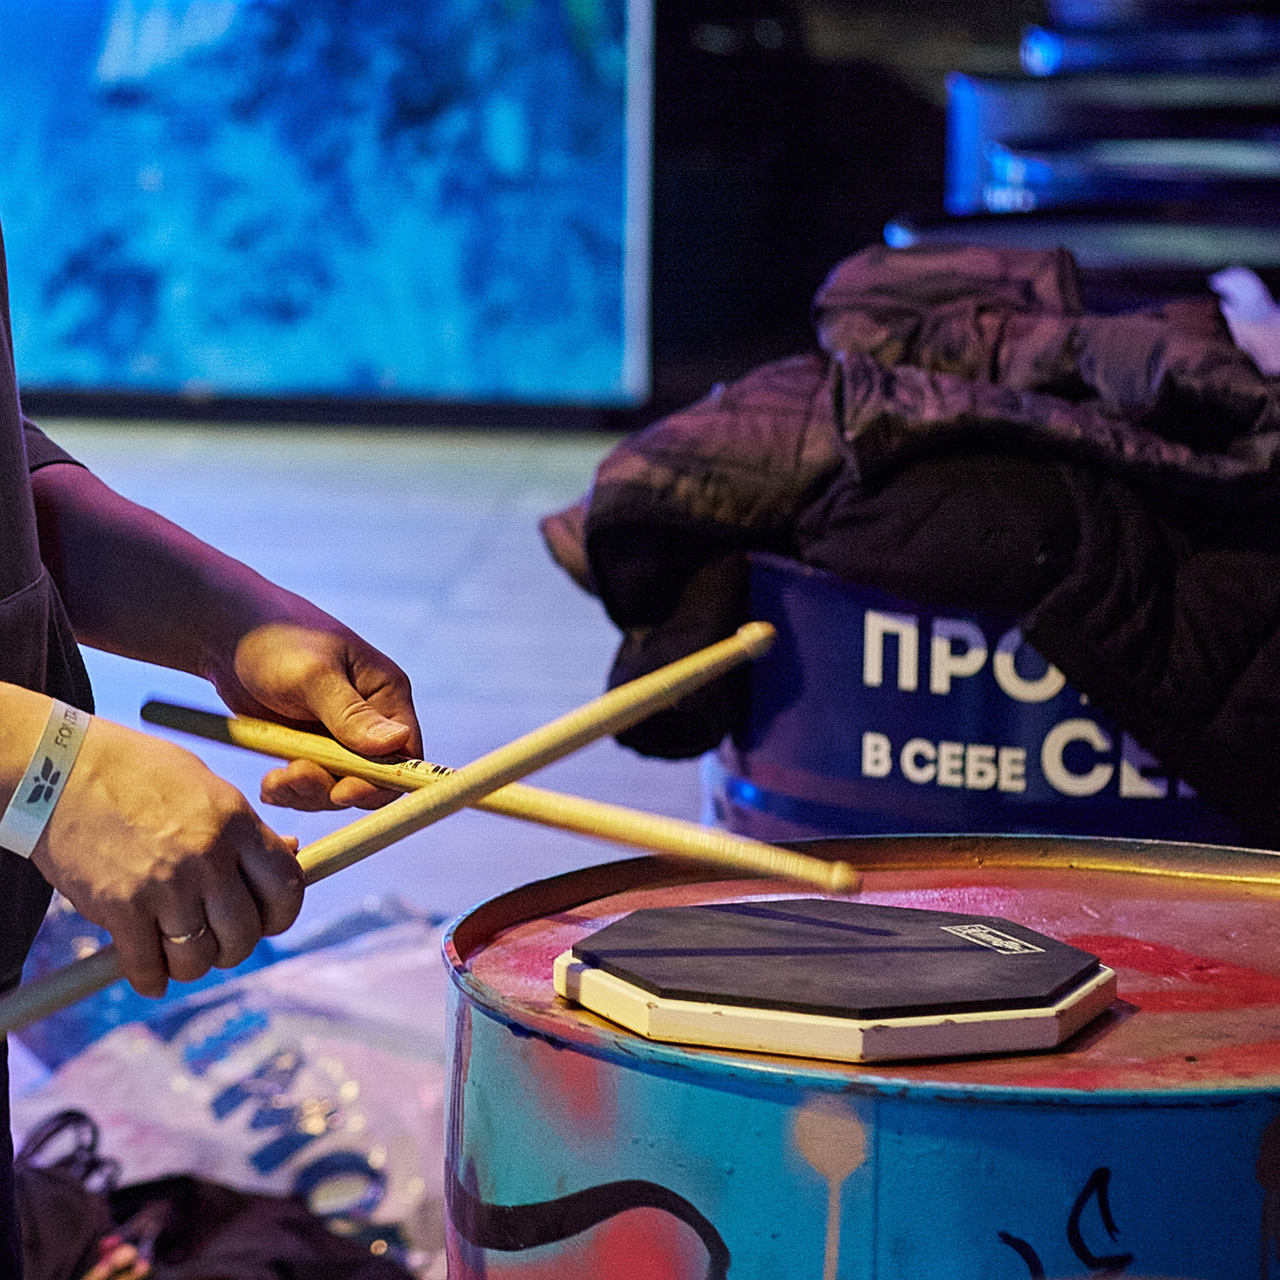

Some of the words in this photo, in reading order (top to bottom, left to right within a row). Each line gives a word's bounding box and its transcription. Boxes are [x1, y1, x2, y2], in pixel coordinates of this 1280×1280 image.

[863, 610, 1068, 703] ПРО
[861, 731, 892, 778] В
[900, 737, 1027, 793] СЕБЕ
[1040, 718, 1200, 800] СЕ
